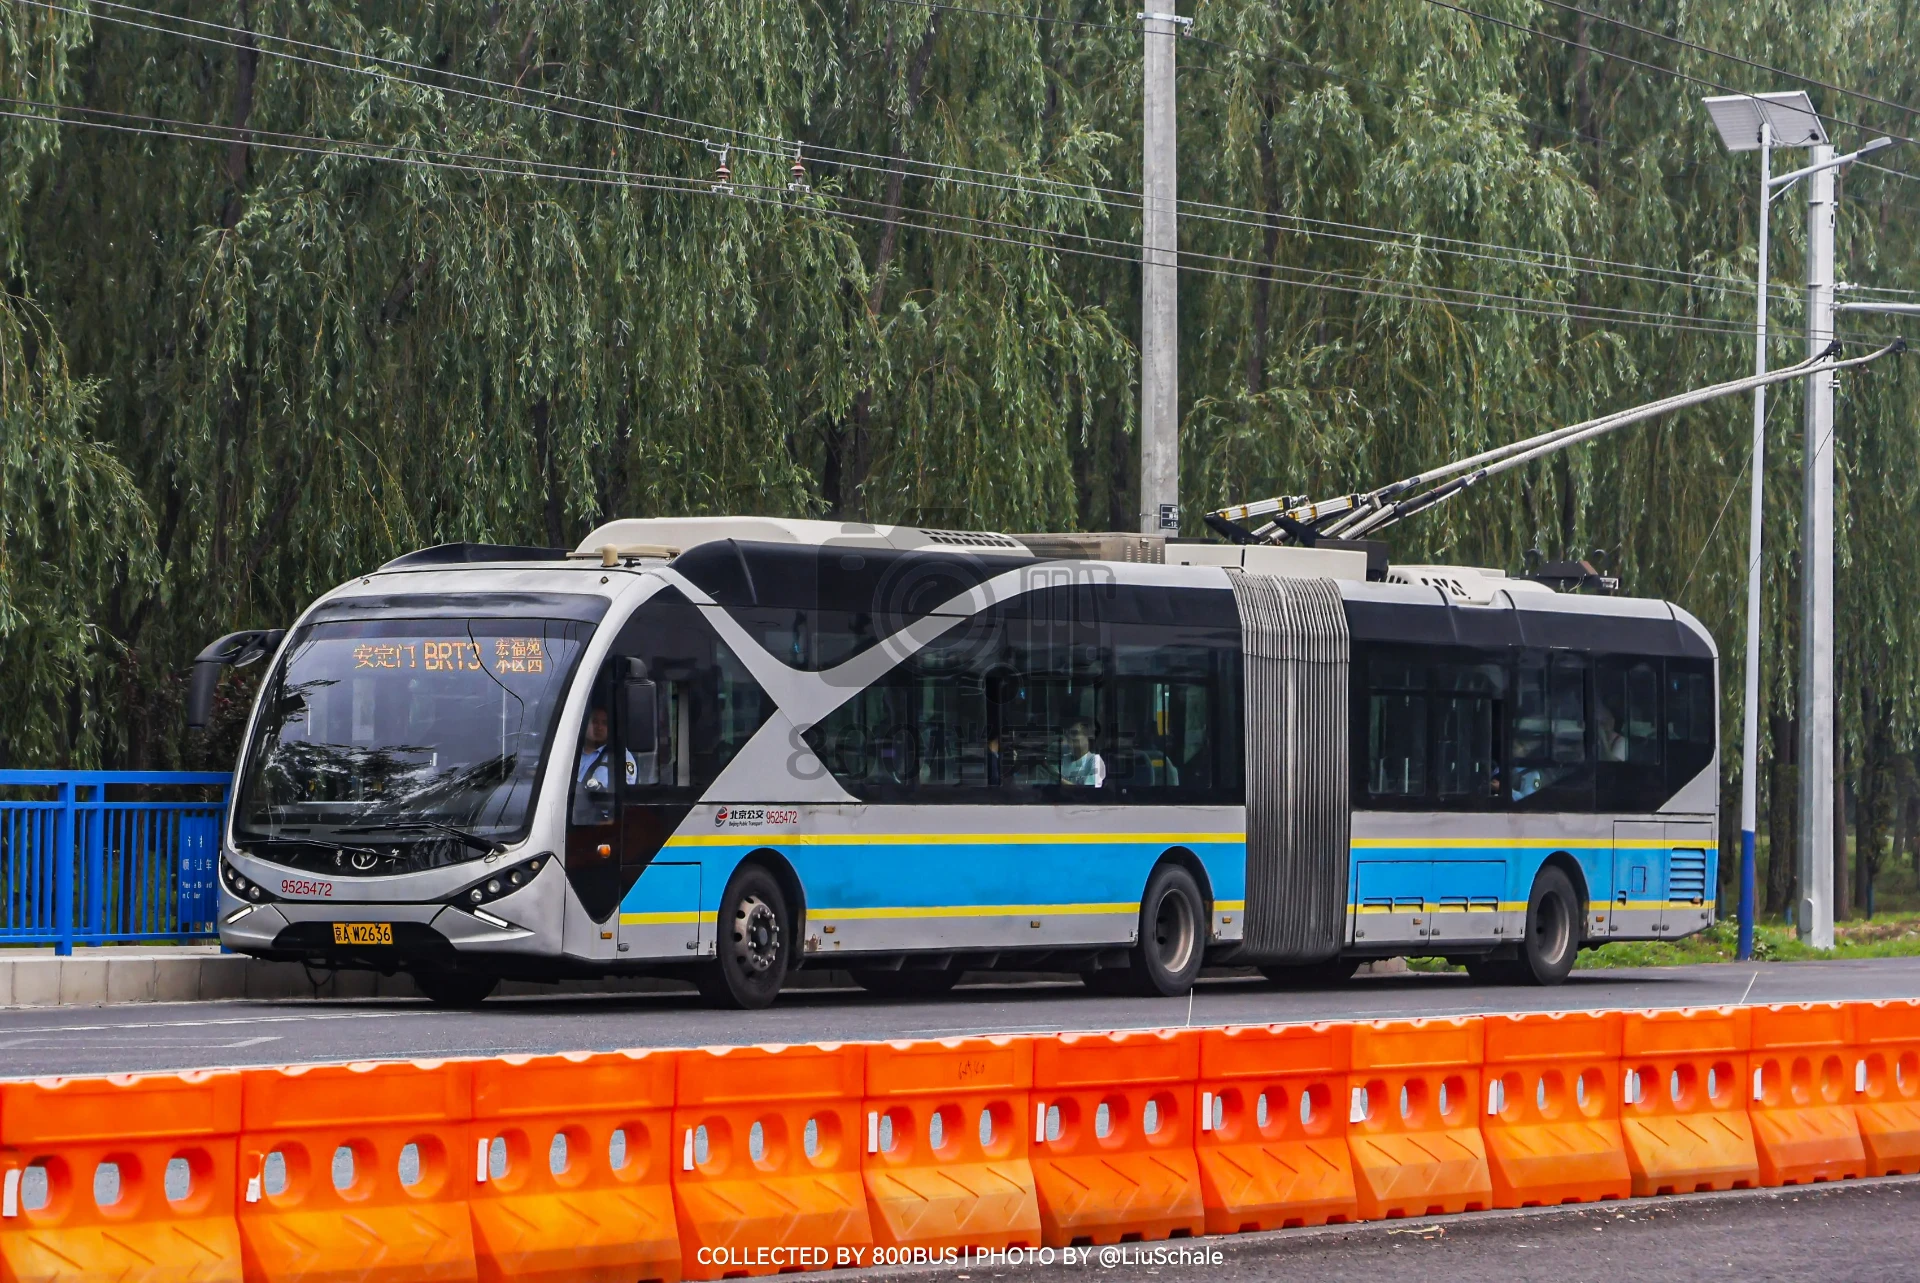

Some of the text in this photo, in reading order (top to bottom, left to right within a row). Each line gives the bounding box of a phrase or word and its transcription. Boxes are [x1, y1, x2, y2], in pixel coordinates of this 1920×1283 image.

[495, 638, 542, 655] 宏福苑
[353, 642, 482, 670] 安定门 BRT3
[730, 810, 798, 824] 北京公交 9525472
[281, 880, 333, 896] 9525472
